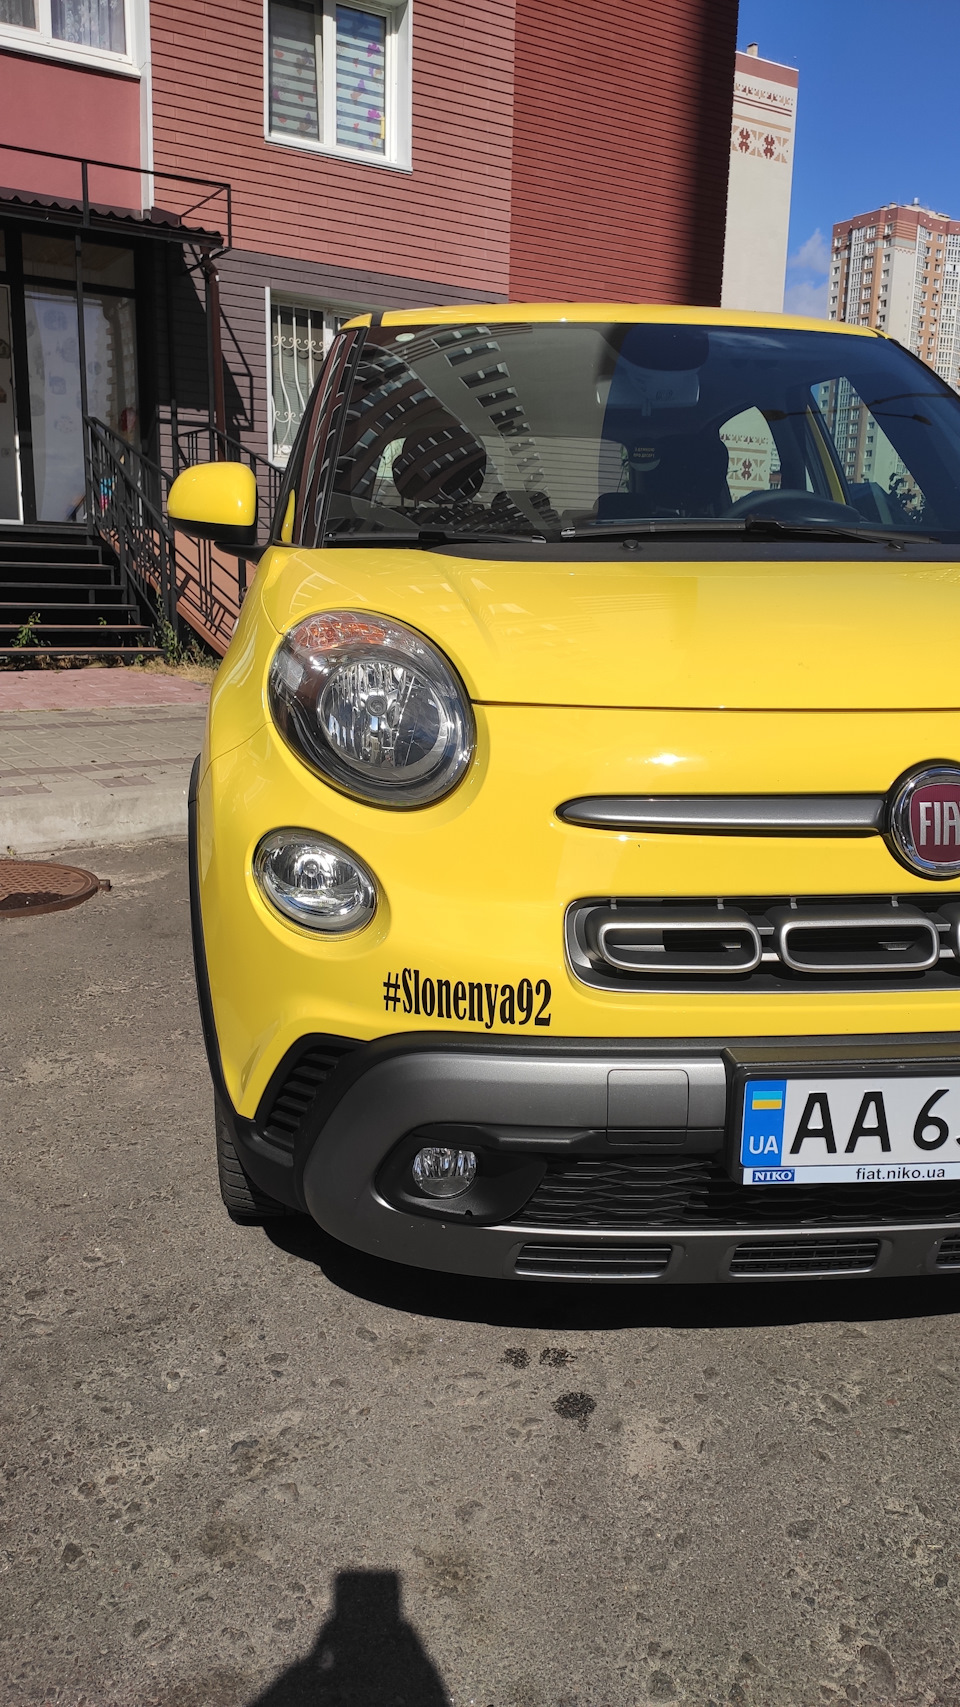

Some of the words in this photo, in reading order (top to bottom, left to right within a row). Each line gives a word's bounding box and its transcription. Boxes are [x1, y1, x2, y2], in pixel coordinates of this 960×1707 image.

[919, 801, 960, 846] FIA
[383, 968, 552, 1029] #Slonenya92
[913, 1089, 960, 1151] 6
[749, 1135, 779, 1154] UA
[754, 1171, 792, 1181] NIKO
[856, 1167, 945, 1180] fiat.niko.ua
